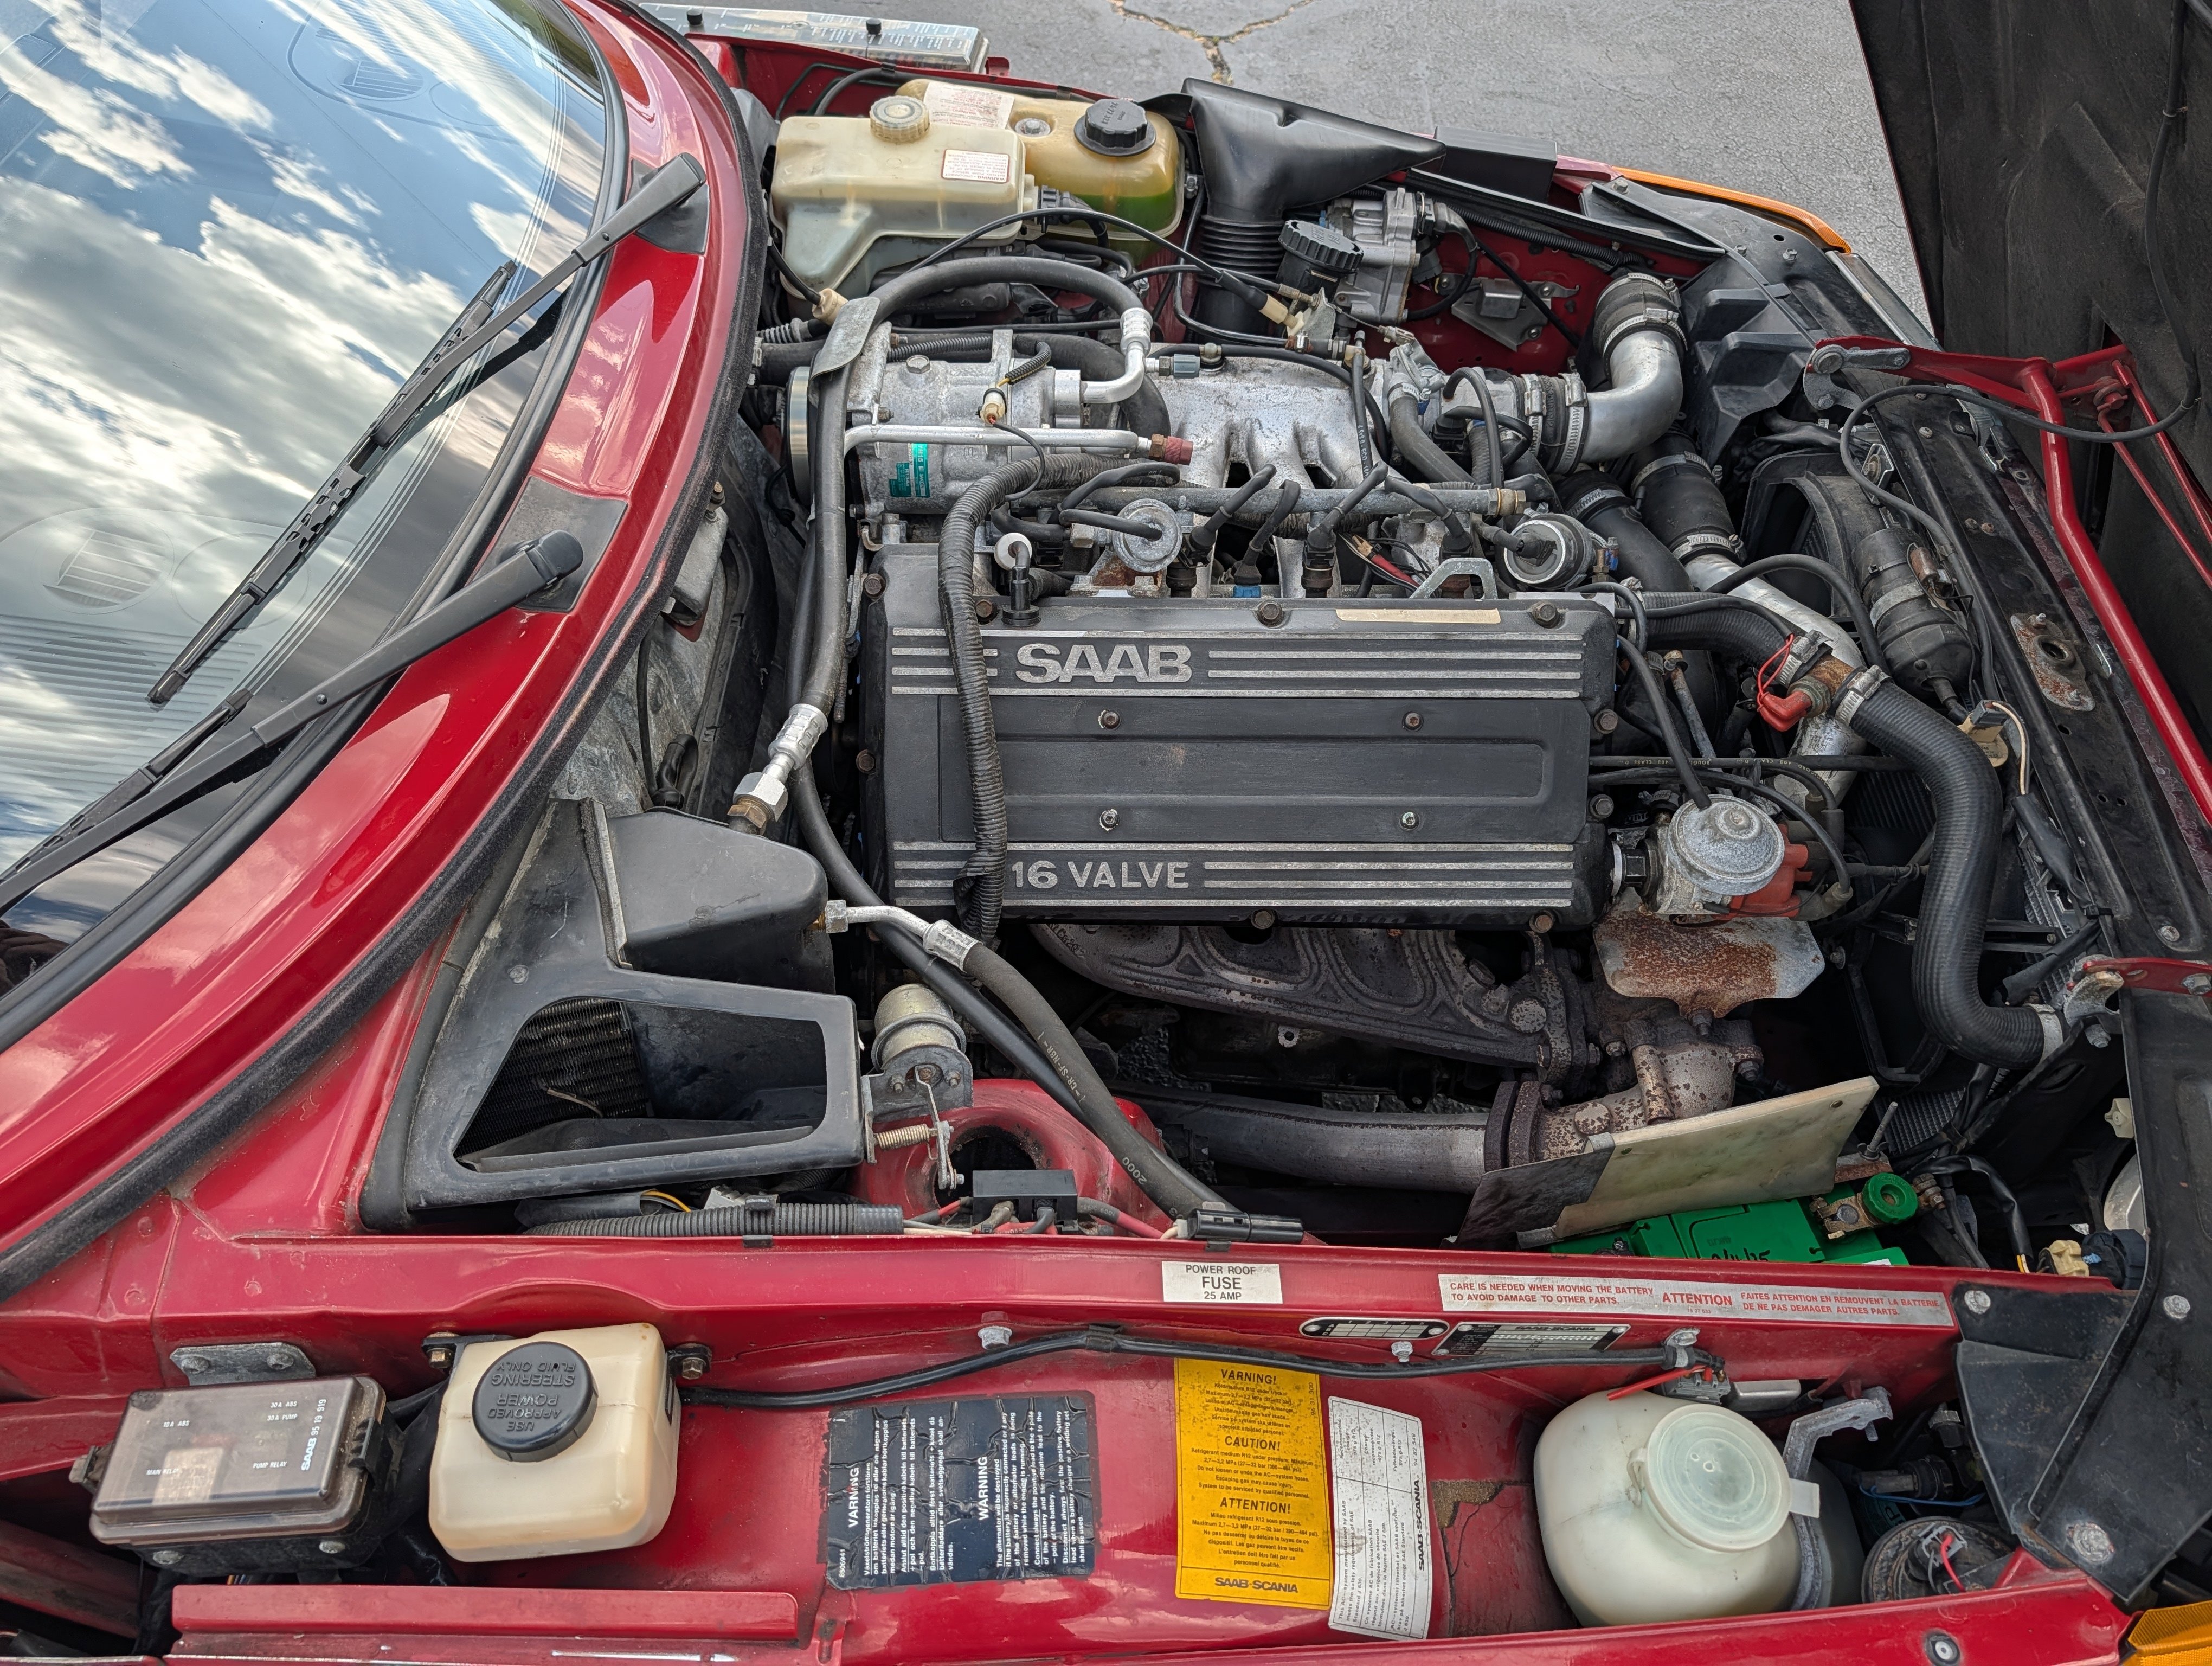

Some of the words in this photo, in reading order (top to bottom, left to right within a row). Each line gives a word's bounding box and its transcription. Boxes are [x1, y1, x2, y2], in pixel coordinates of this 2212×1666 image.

[1015, 643, 1193, 683] SAAB
[1012, 860, 1058, 889] 16
[1068, 862, 1189, 888] VALVE
[1186, 1264, 1223, 1274] POWER
[1227, 1266, 1256, 1275] ROOF
[1202, 1276, 1242, 1290] FUSE
[1450, 1283, 1475, 1291] CARE
[1478, 1283, 1487, 1291] IS
[1489, 1283, 1525, 1291] NEEDED
[1528, 1284, 1554, 1292] WHEN
[1557, 1284, 1592, 1293] MOVING
[1615, 1286, 1654, 1295] BATTERY
[1204, 1291, 1216, 1299] 25
[1220, 1291, 1242, 1300] AMP
[1467, 1293, 1495, 1302] AVOID
[1498, 1294, 1536, 1302] DAMAGE
[1541, 1295, 1553, 1303] TO
[1556, 1295, 1586, 1303] OTHER
[1662, 1292, 1733, 1305] ATTENTION
[1740, 1292, 1770, 1301] FAITES
[1773, 1293, 1817, 1303] ATTENTION
[1820, 1295, 1831, 1303] EN
[1834, 1296, 1884, 1305] REMOUVENT
[1887, 1297, 1899, 1305] LA
[1901, 1298, 1940, 1307] BATTERIE
[1757, 1303, 1769, 1311] NE
[1771, 1303, 1788, 1311] PAS
[1790, 1304, 1832, 1313] DEMAGER
[1836, 1305, 1869, 1314] AUTRES
[1871, 1307, 1900, 1316] PARTS.
[497, 1361, 532, 1372] ONLY
[538, 1362, 576, 1372] FLUID
[491, 1373, 576, 1386] STEERING
[1221, 1369, 1277, 1385] VARNING!
[317, 1399, 326, 1412] 919
[497, 1394, 559, 1406] POWER
[487, 1408, 562, 1419] APPROVED
[1310, 1407, 1316, 1416] 96
[314, 1415, 323, 1424] 19
[311, 1426, 320, 1436] 95
[506, 1421, 534, 1432] USE
[1225, 1436, 1281, 1451] CAUTION!
[301, 1437, 317, 1471] SAAB
[1191, 1447, 1219, 1456] Refrigerant
[1412, 1447, 1417, 1456] 82
[1413, 1458, 1418, 1466] 94
[1216, 1475, 1239, 1484] Escaping
[977, 1456, 989, 1521] WARNING
[848, 1466, 860, 1528] VARNING
[901, 1485, 909, 1513] positiva
[994, 1494, 1001, 1503] be
[1220, 1497, 1291, 1514] ATTENTION!
[838, 1548, 846, 1578] 8506941
